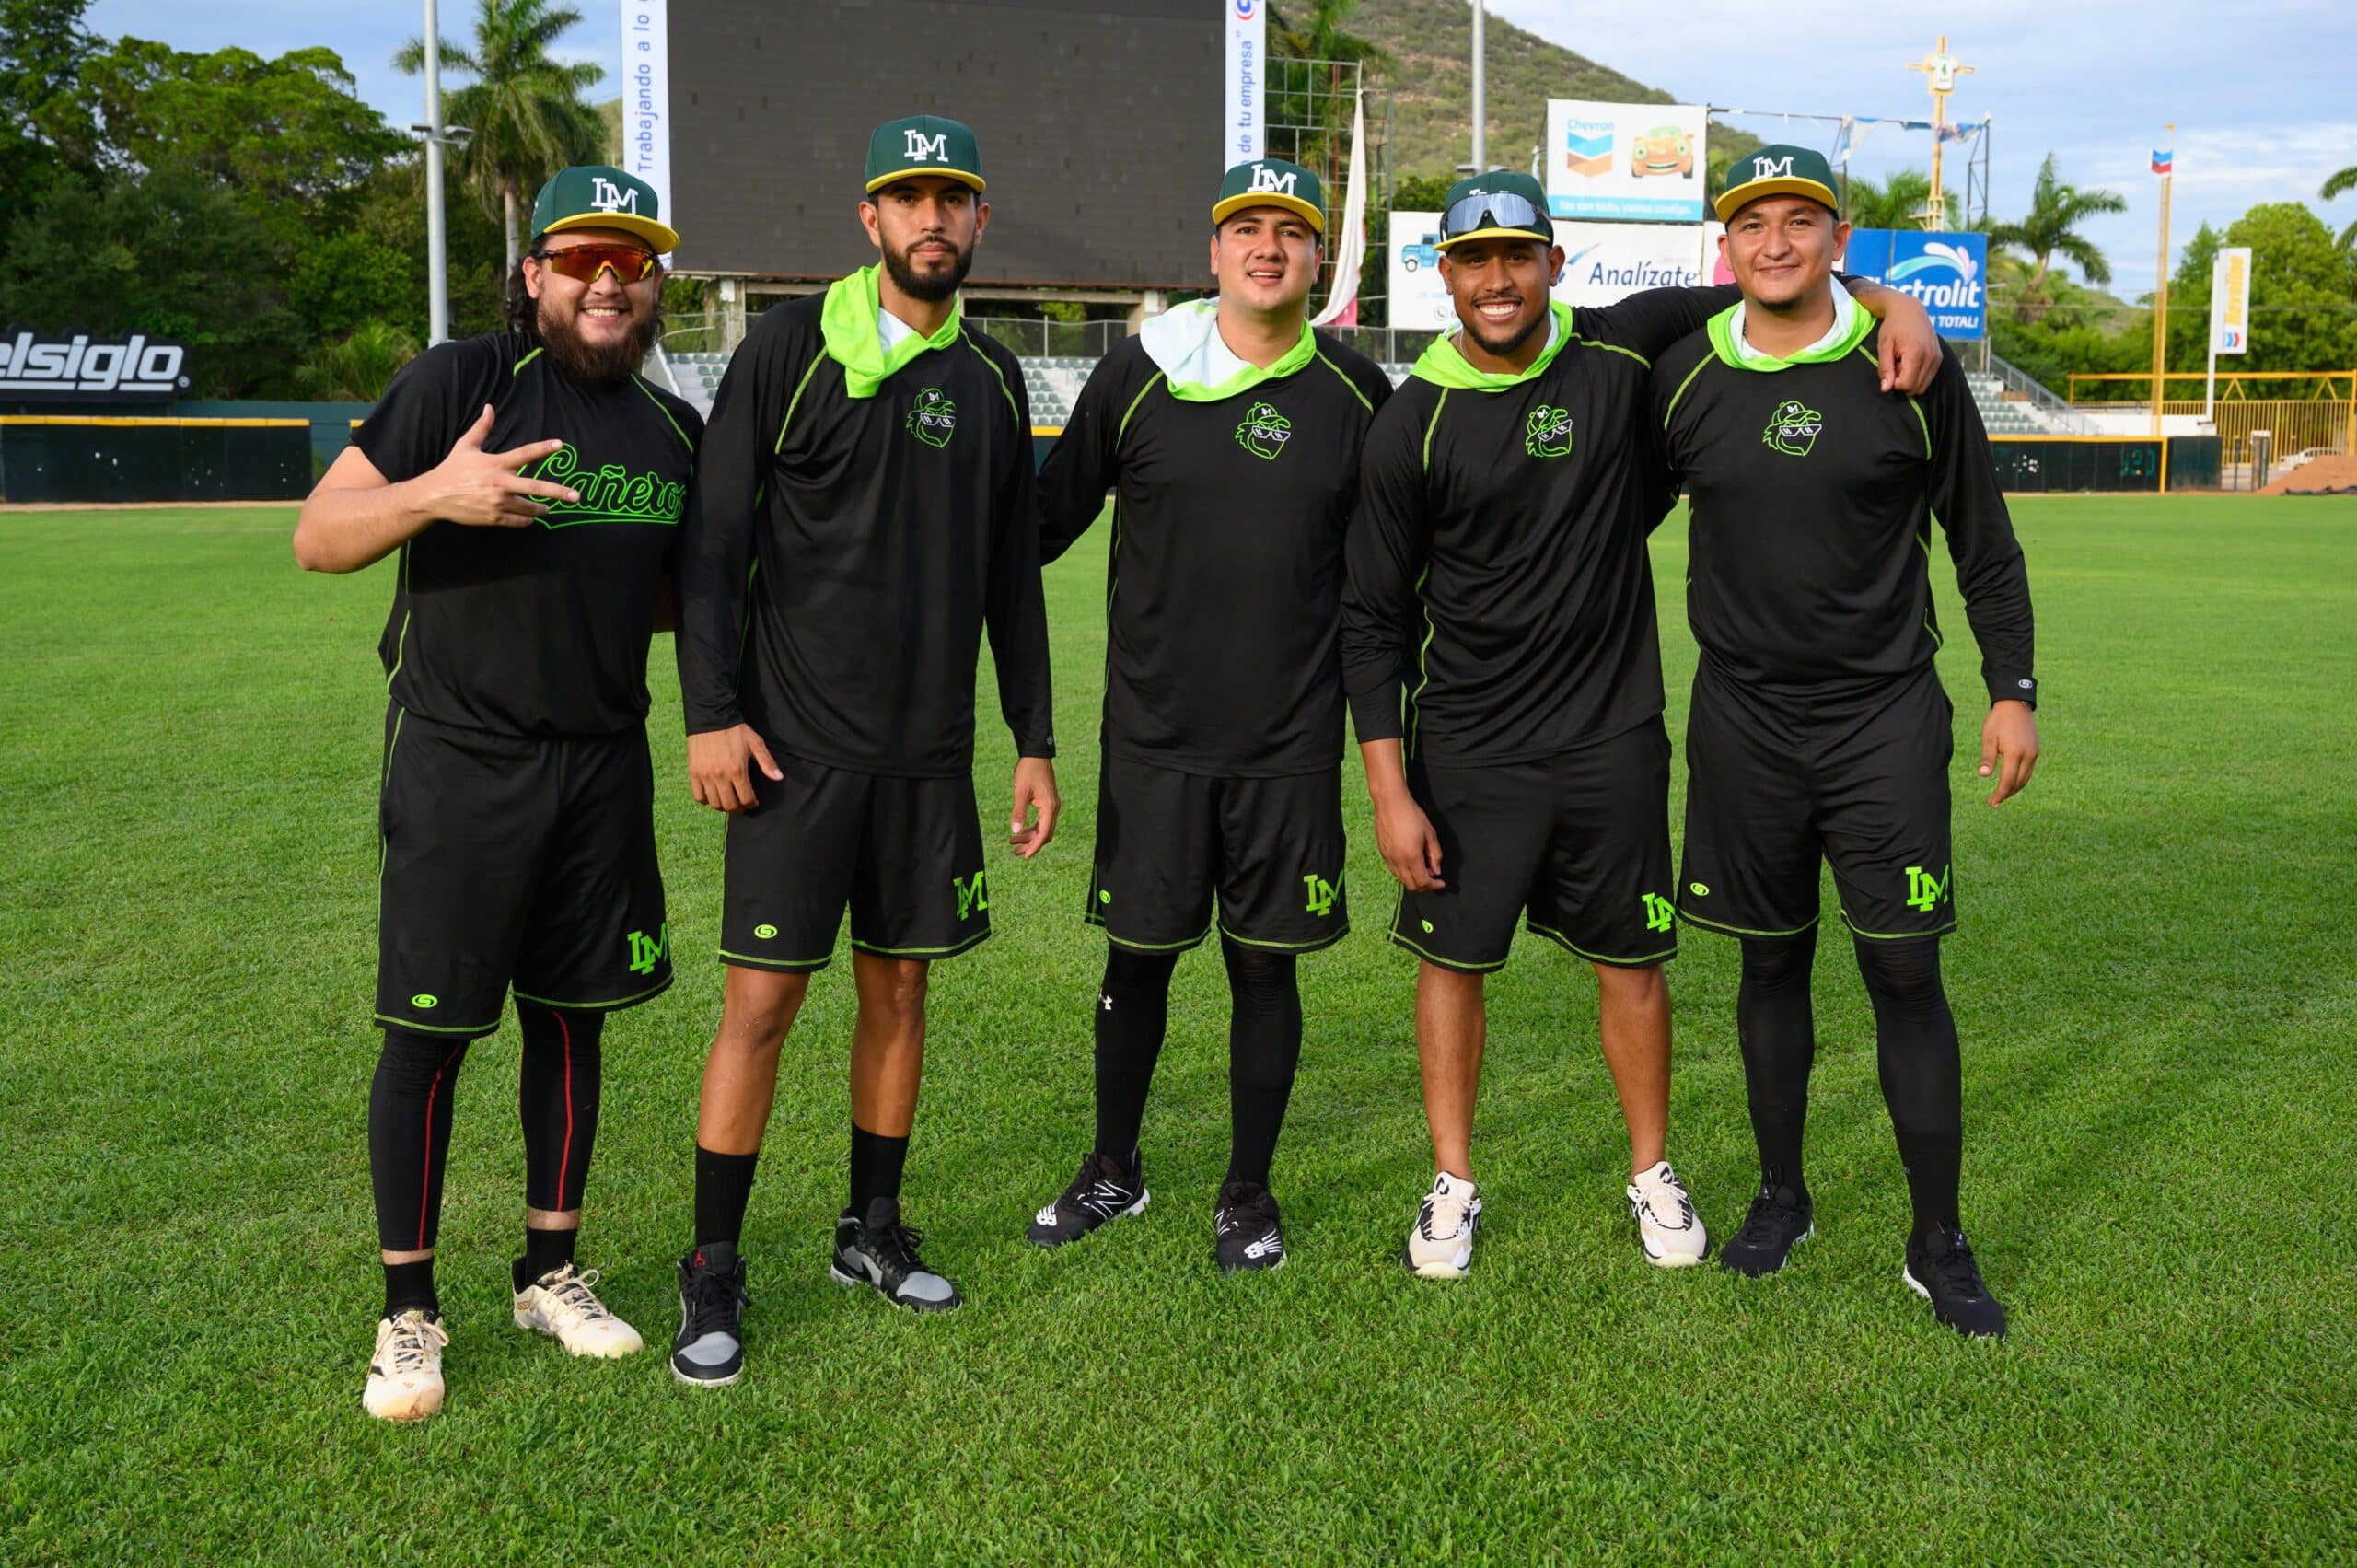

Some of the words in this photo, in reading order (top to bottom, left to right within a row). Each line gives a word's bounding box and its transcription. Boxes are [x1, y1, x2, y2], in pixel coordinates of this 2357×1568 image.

[633, 14, 650, 31] lo
[638, 41, 651, 52] a
[633, 64, 659, 172] Trabajando
[1237, 111, 1252, 127] tu
[904, 129, 948, 162] LM
[1237, 134, 1252, 154] de
[1248, 164, 1297, 196] LM
[1751, 156, 1796, 181] LM
[591, 178, 639, 215] LM
[1588, 261, 1698, 287] Analízate
[1303, 869, 1344, 916] LM
[1905, 864, 1949, 912] LM
[627, 922, 668, 975] LM
